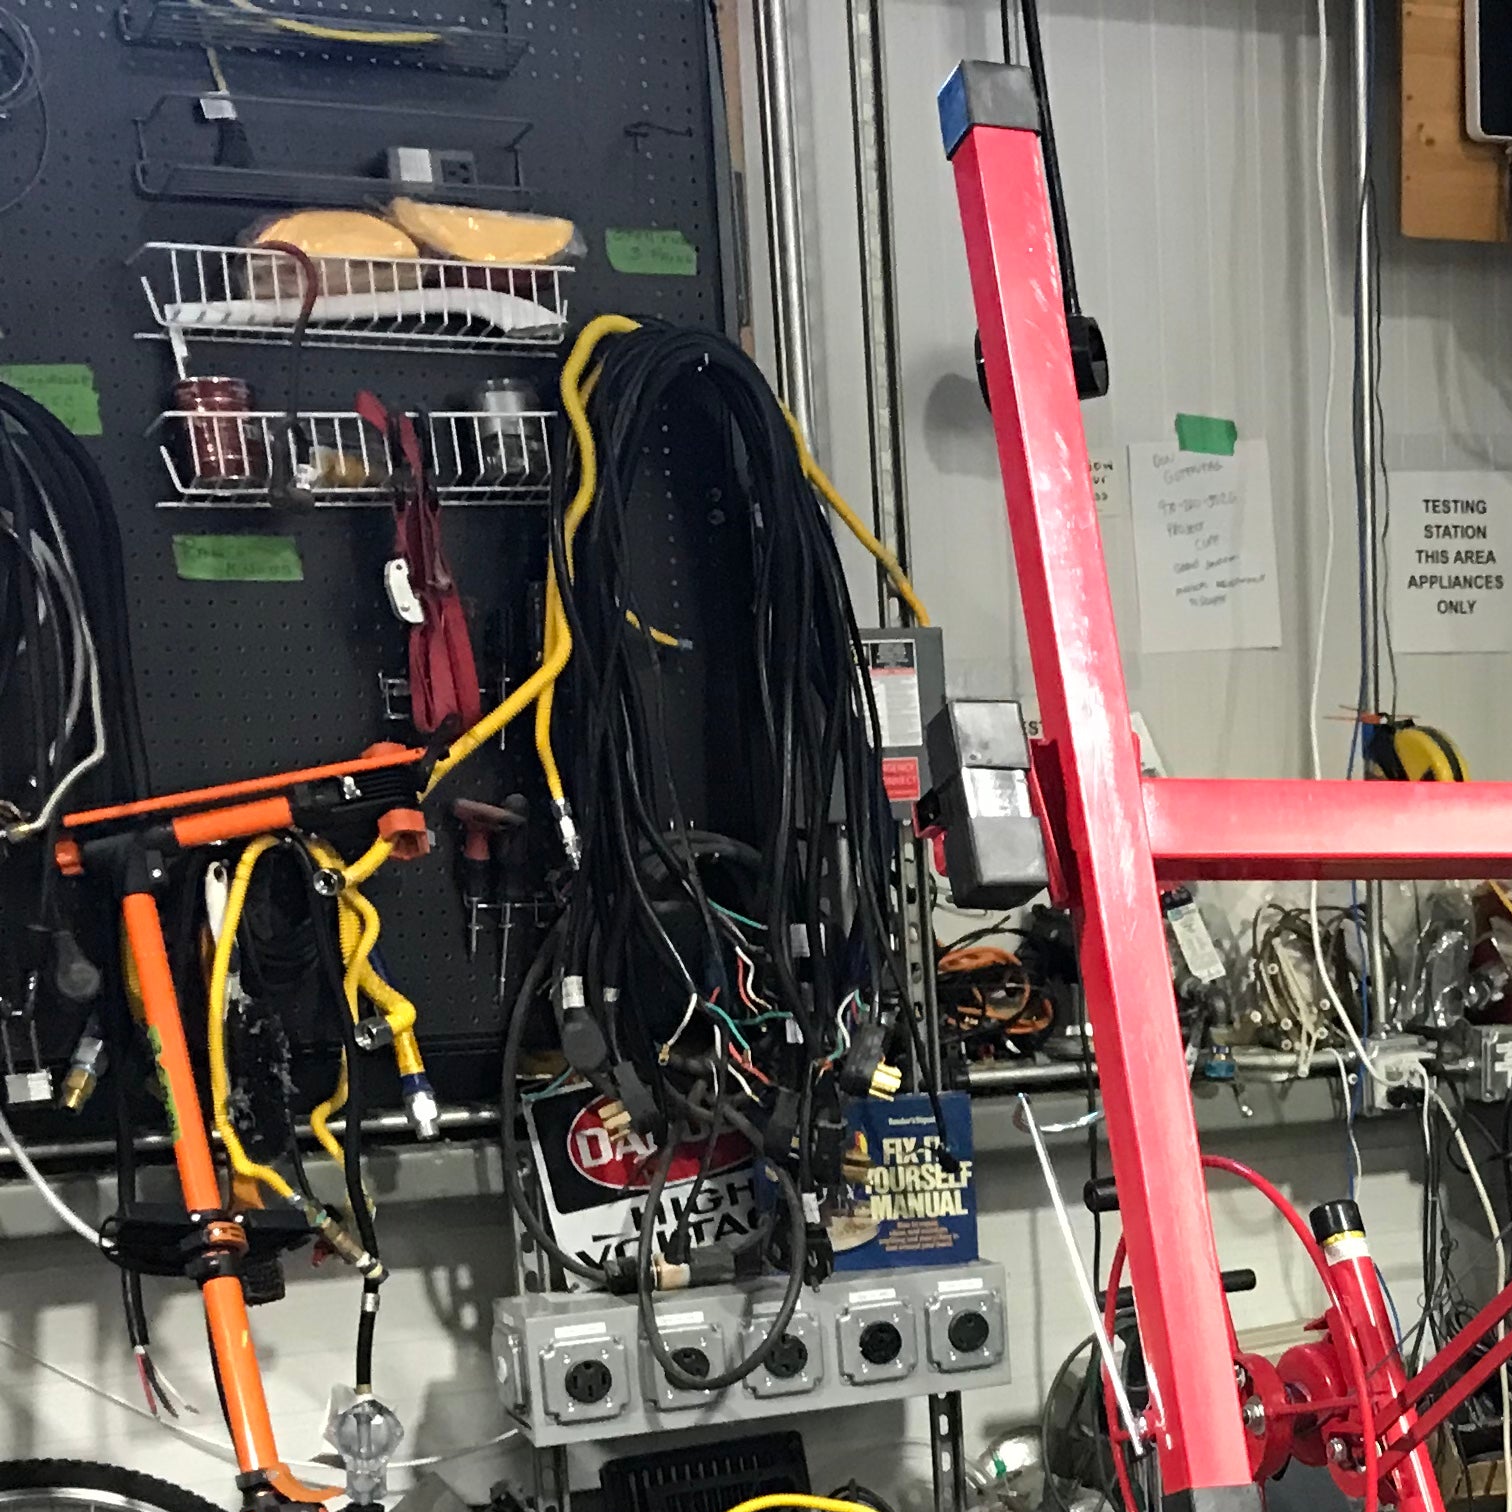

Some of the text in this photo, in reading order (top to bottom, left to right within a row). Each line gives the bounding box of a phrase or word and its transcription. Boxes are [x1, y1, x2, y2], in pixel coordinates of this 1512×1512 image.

[1422, 499, 1487, 514] TESTING
[1424, 524, 1487, 539] STATION
[1416, 549, 1497, 564] THIS AREA
[1407, 574, 1504, 589] APPLIANCES
[1437, 600, 1477, 614] ONLY
[869, 1189, 969, 1220] MANUAL
